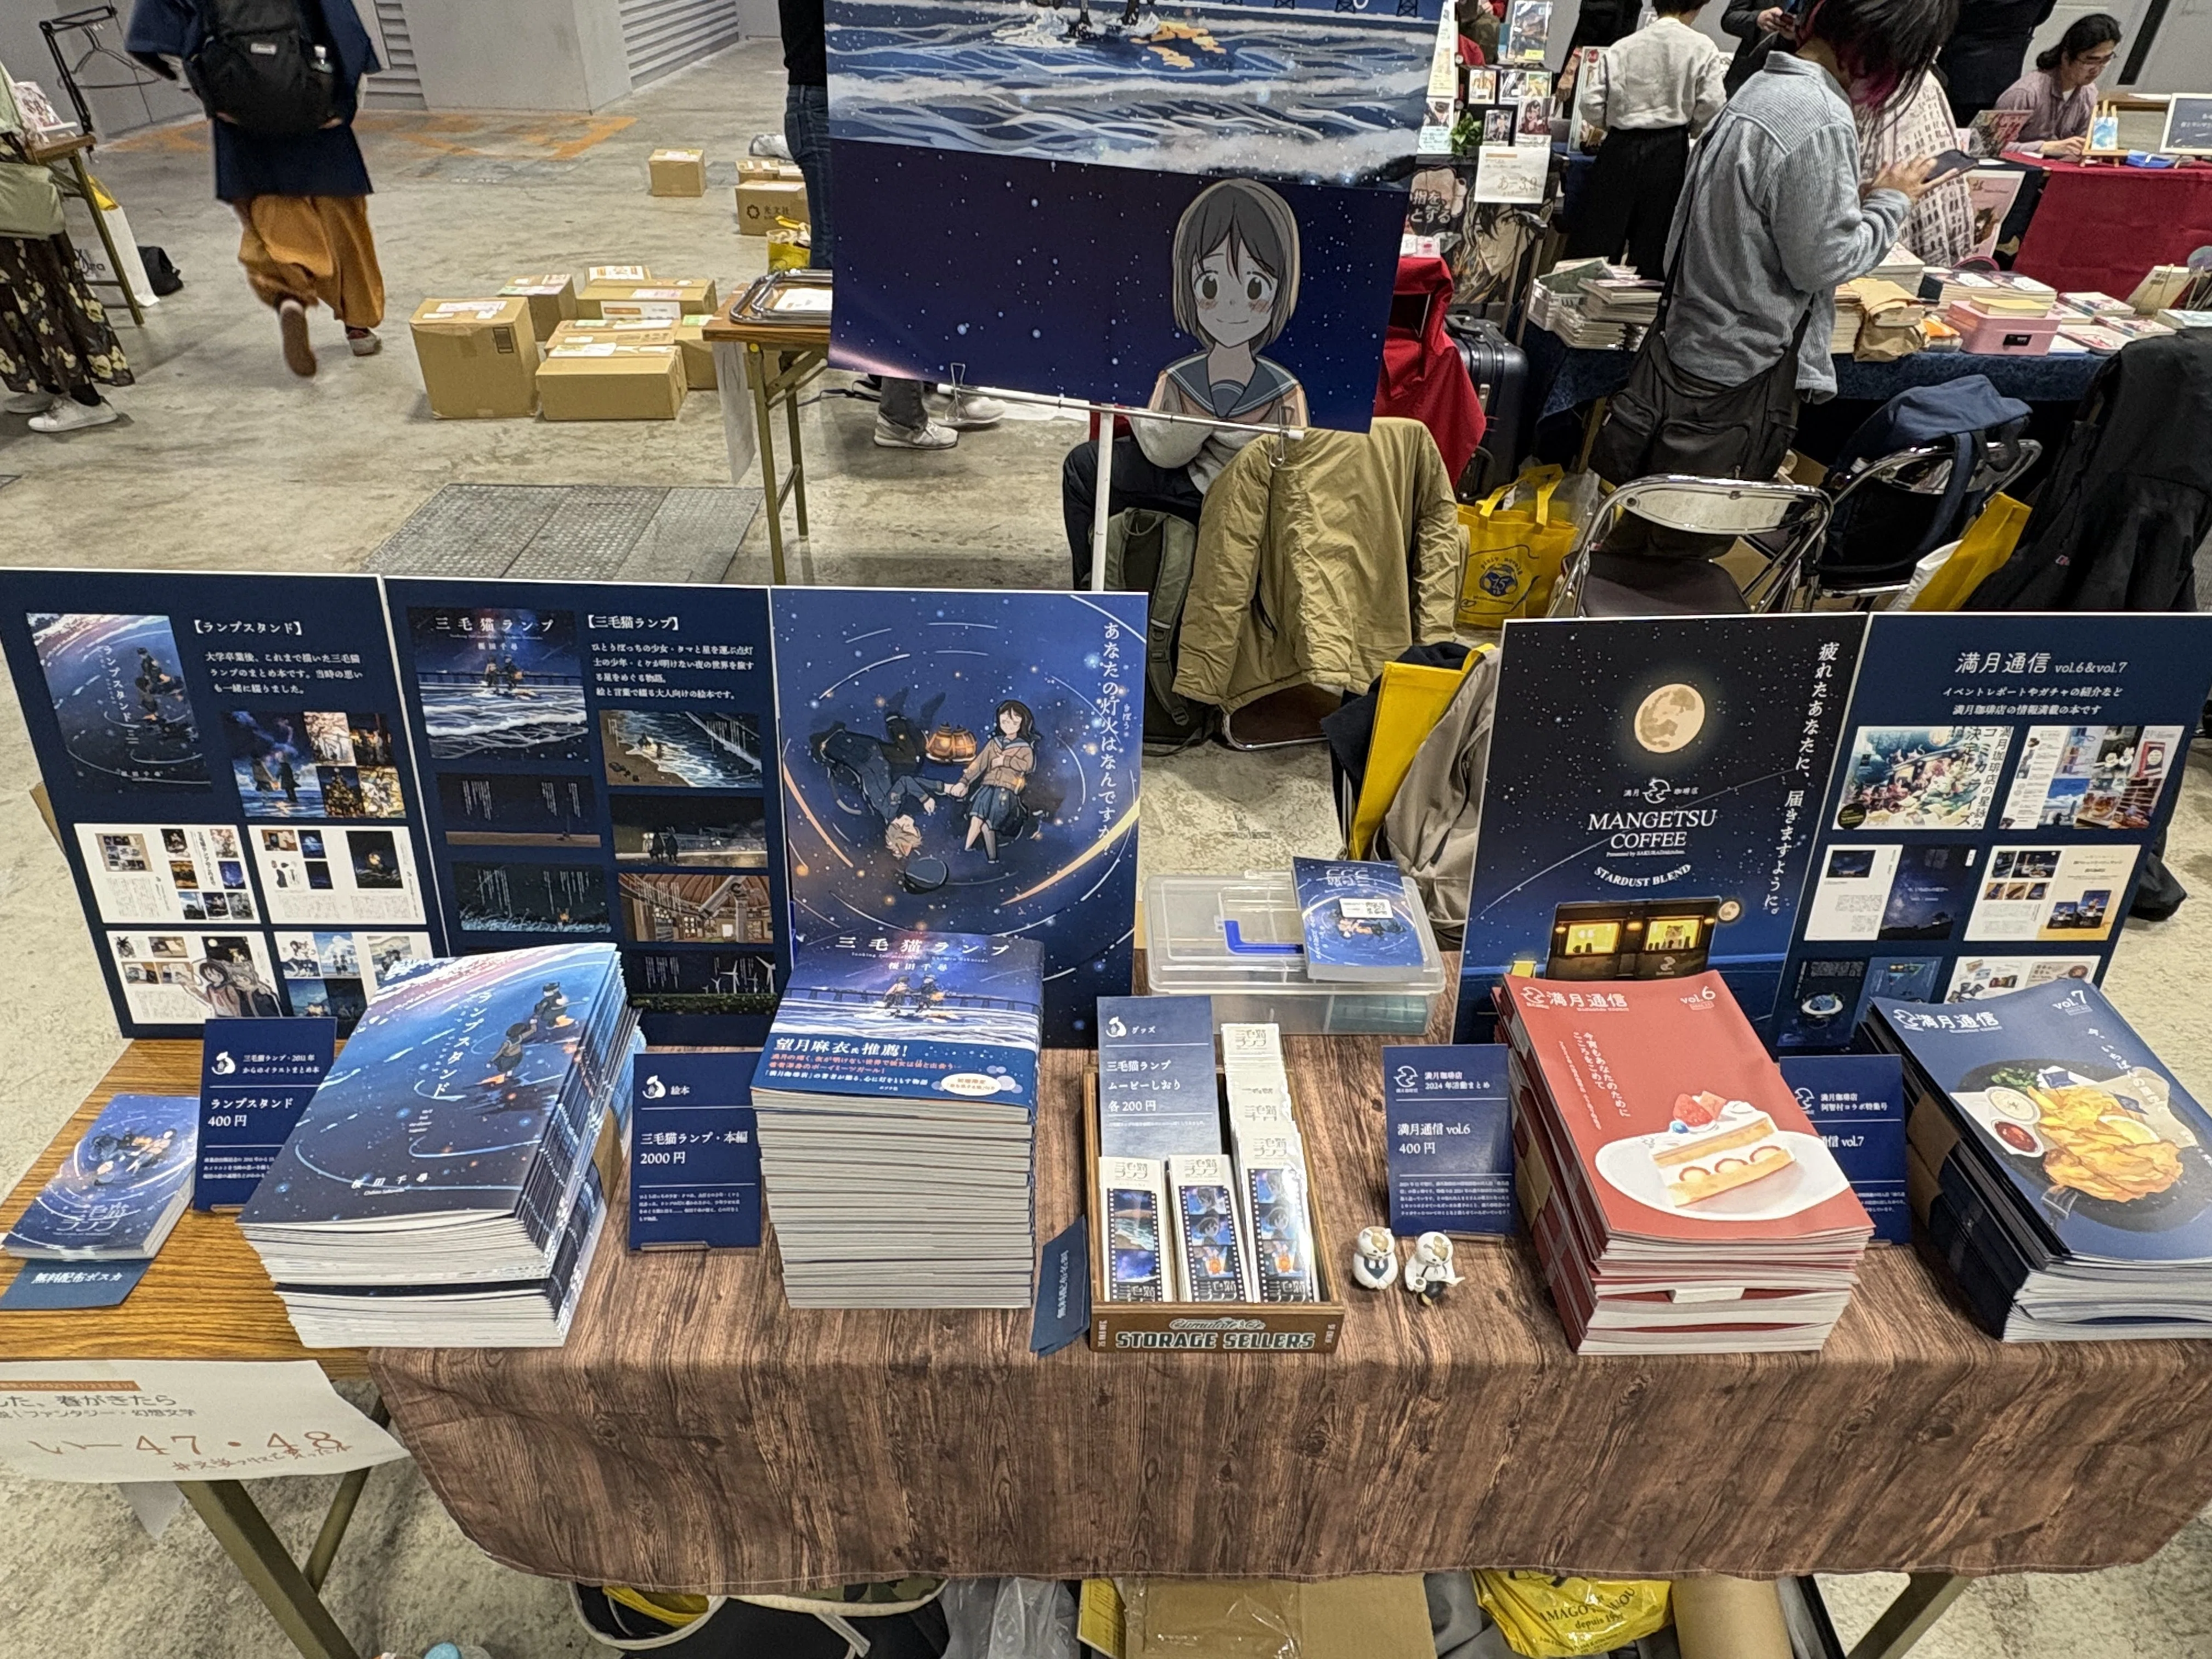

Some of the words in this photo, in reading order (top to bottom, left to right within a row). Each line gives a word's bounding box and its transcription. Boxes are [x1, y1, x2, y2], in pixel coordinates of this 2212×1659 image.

[1406, 207, 1451, 224] とする
[194, 619, 302, 636] 【ランプスタンド】
[435, 616, 554, 632] 三毛猫ランプ
[588, 614, 679, 631] 【三毛猫ランプ】
[1954, 651, 2052, 675] 満月通信
[1942, 686, 2124, 698] イベントレポートやガチャの紹介など
[1795, 641, 1841, 778] 疲れたあなたに、
[1587, 809, 1718, 831] MANGETSU
[1610, 831, 1688, 849] COFFEE
[1763, 789, 1805, 916] 届きますように。
[1594, 866, 1651, 888] STARDUST
[1652, 864, 1692, 885] BLEND
[834, 936, 1009, 957] 三毛猫ランプ
[1546, 990, 1628, 1008] 満月通信
[1680, 985, 1717, 1005] vol.6
[2052, 989, 2087, 1011] vol.7
[1918, 1011, 2000, 1030] 満月通信
[1131, 1025, 1156, 1035] グッズ
[1106, 1059, 1172, 1073] 三毛猫ランプ
[1108, 1079, 1181, 1091] ムービーしおり
[210, 1097, 294, 1110] ランプスタンド
[640, 1130, 748, 1146] 三毛猫ランプ・本編
[1397, 1122, 1444, 1137] 満月通信
[1446, 1124, 1471, 1136] vol.6
[1841, 1135, 1865, 1148] vol.7
[31, 1271, 124, 1284] 無料配布ポスカ
[1115, 1331, 1218, 1349] STORAGE
[1223, 1332, 1316, 1350] SELLERS
